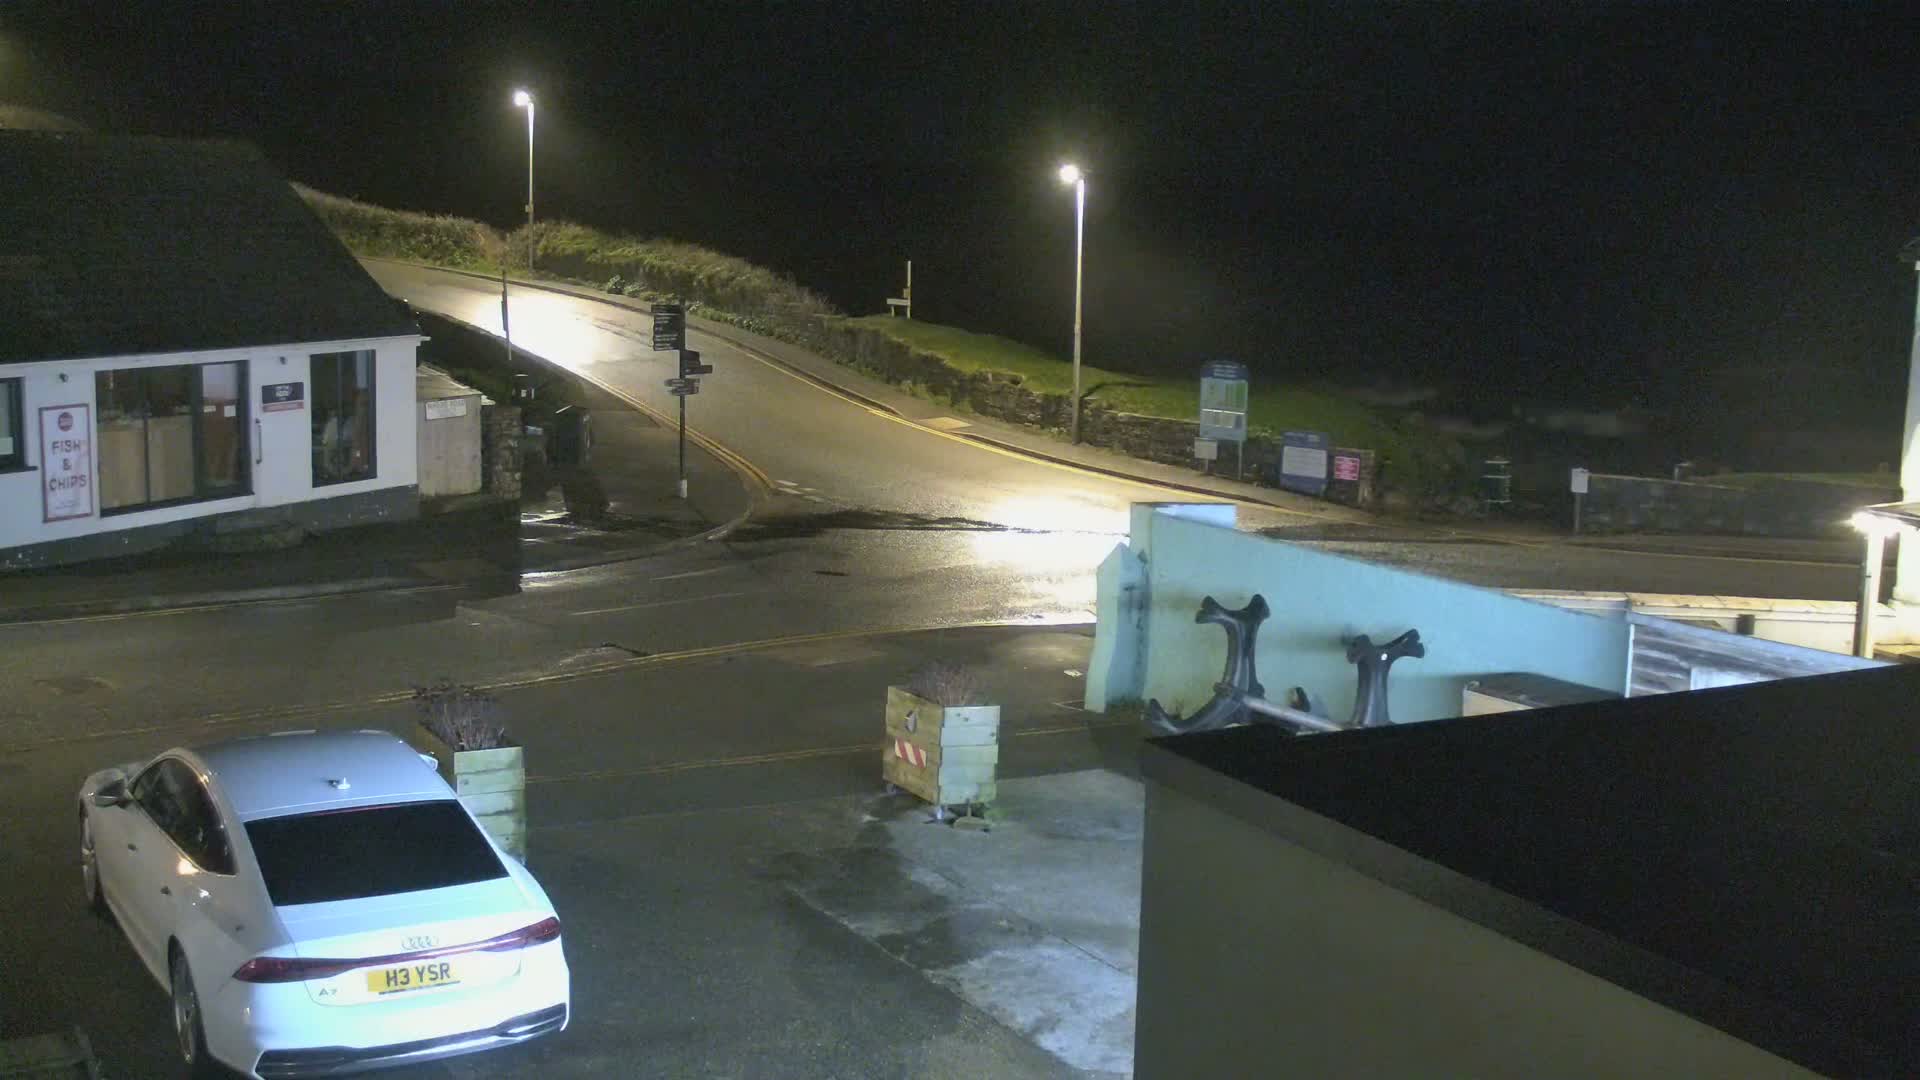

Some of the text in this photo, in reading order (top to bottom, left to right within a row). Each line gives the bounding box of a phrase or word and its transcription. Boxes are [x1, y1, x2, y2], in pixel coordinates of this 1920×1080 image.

[52, 440, 81, 453] FISH
[62, 458, 72, 471] &
[48, 475, 87, 491] CHIPS
[385, 962, 451, 988] H3 YSR
